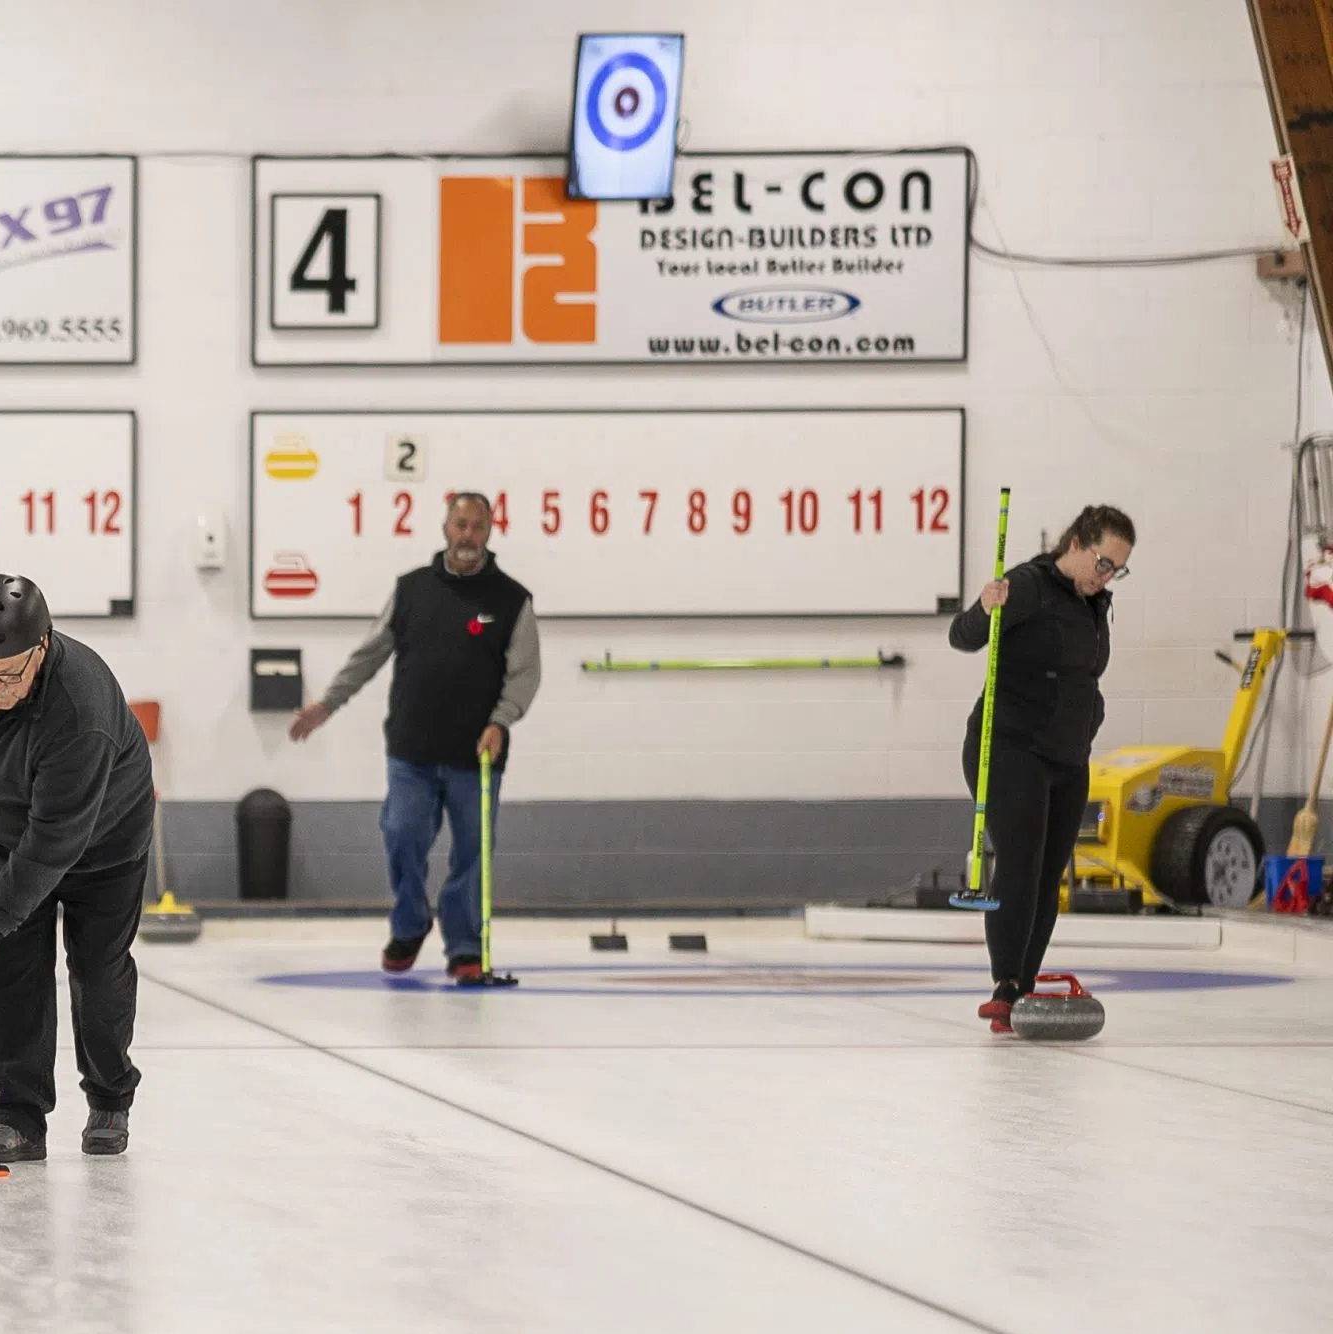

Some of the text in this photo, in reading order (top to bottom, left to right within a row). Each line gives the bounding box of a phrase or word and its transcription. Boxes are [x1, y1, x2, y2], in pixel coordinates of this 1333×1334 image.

[43, 185, 116, 236] 97
[638, 170, 933, 214] EL-CON
[891, 226, 933, 248] LTD
[290, 208, 356, 314] 4
[738, 296, 835, 313] BUTLER
[648, 330, 916, 355] www.bel-con.com
[397, 441, 416, 472] 2
[20, 489, 57, 535] 11
[81, 489, 123, 535] 12
[347, 488, 950, 536] 1 2 4 5 6 7 8 9 10 11 12
